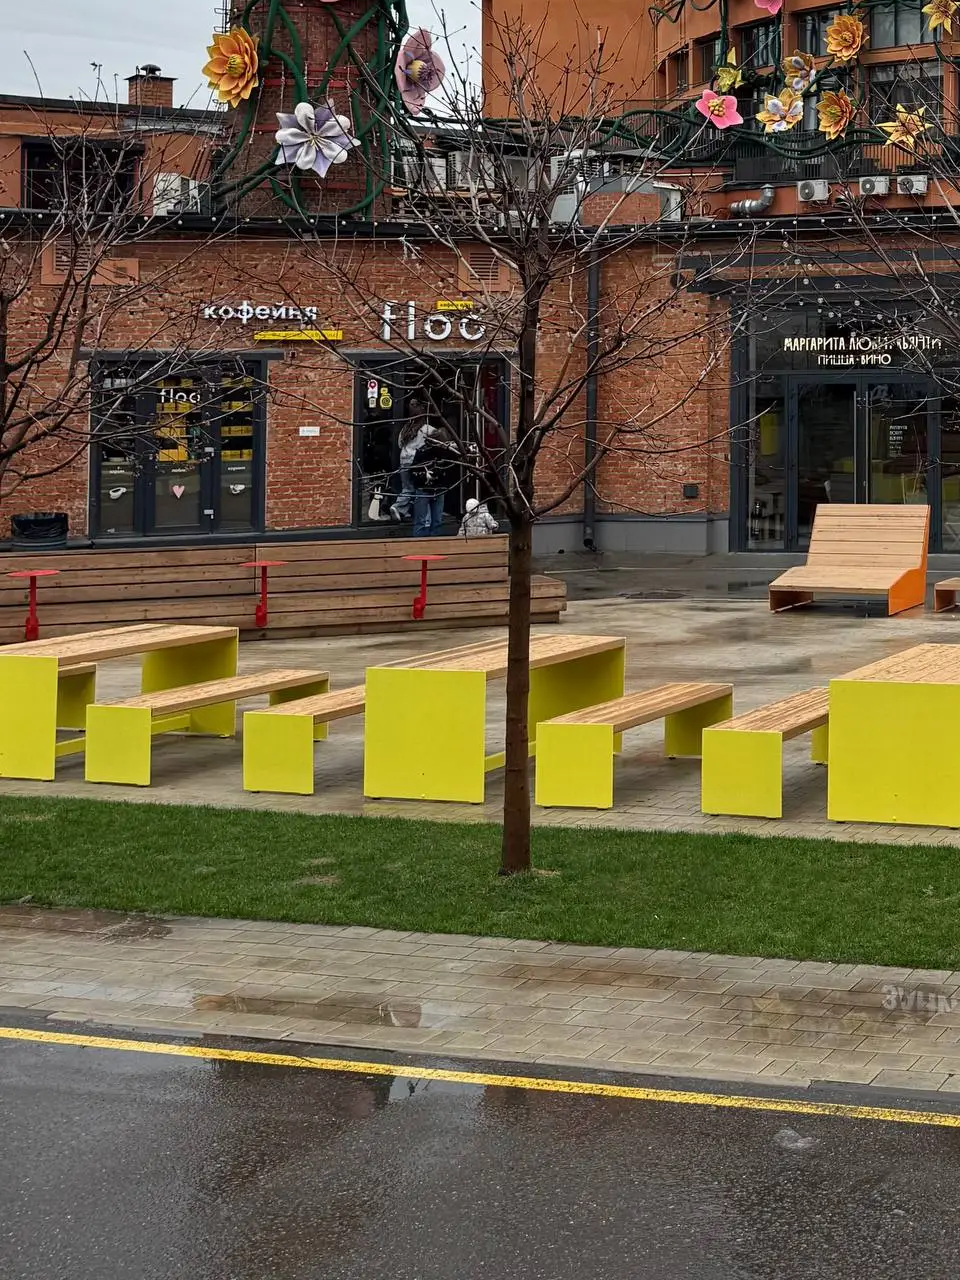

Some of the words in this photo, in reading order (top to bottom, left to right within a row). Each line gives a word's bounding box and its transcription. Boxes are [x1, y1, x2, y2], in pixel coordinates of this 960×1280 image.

[203, 300, 318, 324] кофейня
[783, 336, 846, 352] МАРГАРИТА
[817, 354, 855, 366] ПИЦЦА
[861, 353, 892, 365] ВИНО
